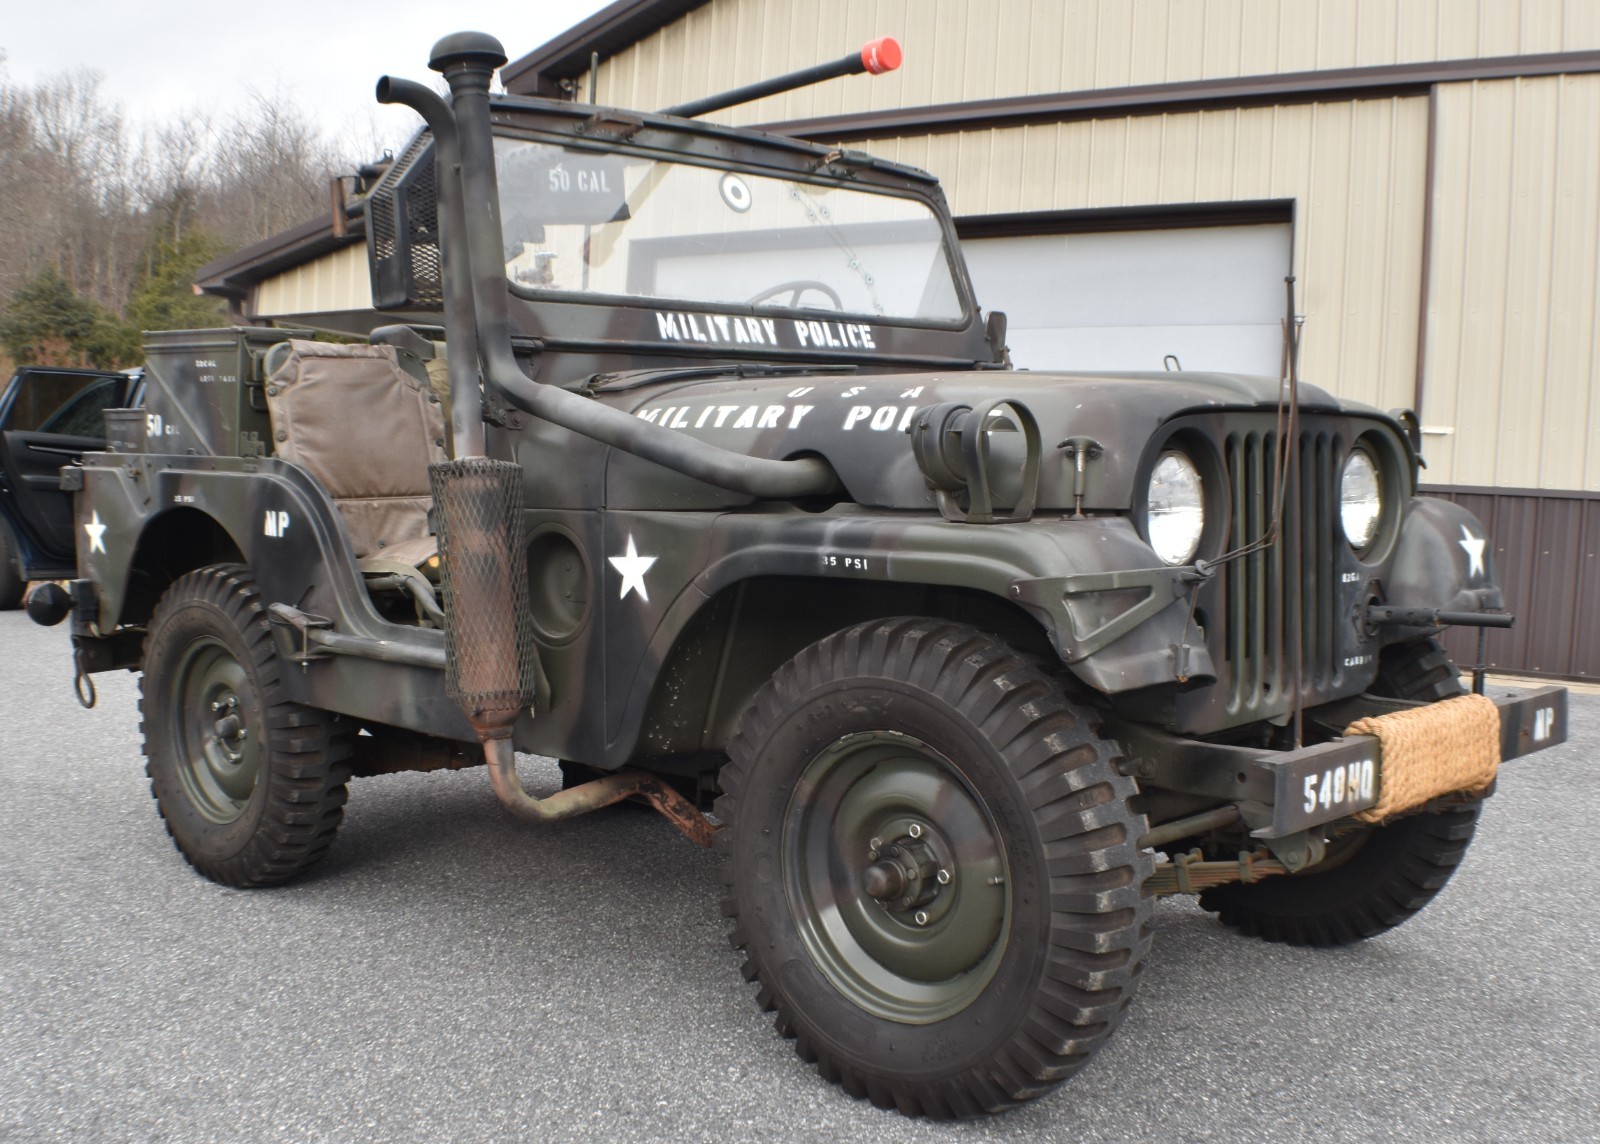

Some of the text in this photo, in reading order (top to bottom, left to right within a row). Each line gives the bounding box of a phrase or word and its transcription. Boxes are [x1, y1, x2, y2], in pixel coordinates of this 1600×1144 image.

[549, 168, 611, 193] 50 CAL
[655, 312, 876, 349] MILITARY POLICE
[787, 386, 925, 398] U S A
[146, 414, 162, 437] 50
[636, 405, 918, 431] MILITARY POL
[264, 510, 290, 537] MP
[822, 556, 868, 570] 35 PSI
[1533, 707, 1554, 741] MP
